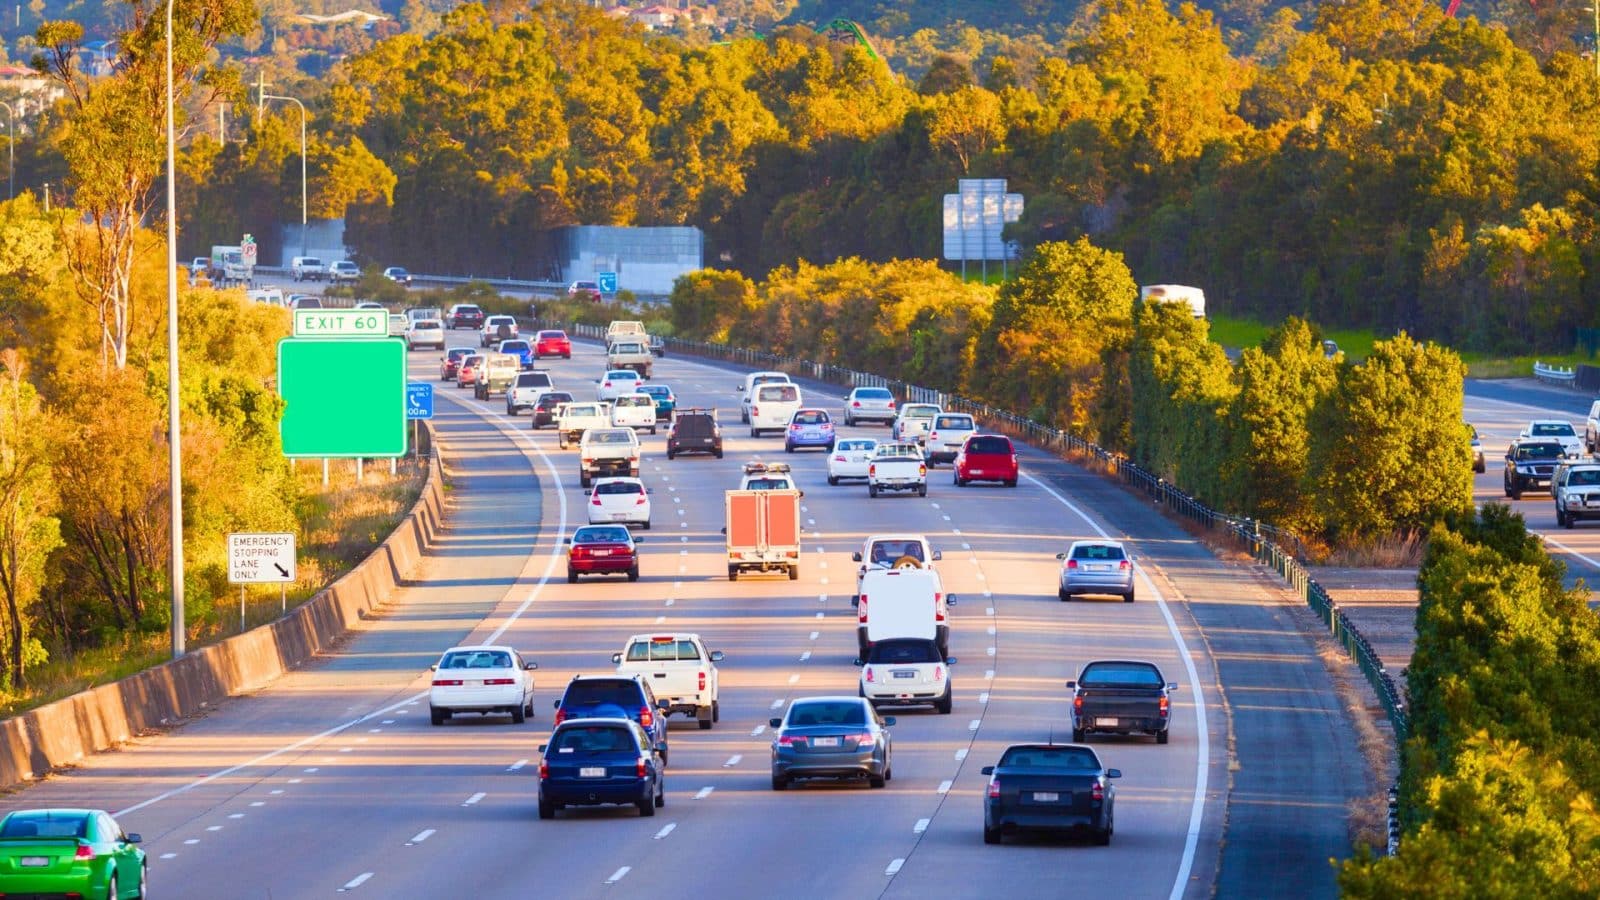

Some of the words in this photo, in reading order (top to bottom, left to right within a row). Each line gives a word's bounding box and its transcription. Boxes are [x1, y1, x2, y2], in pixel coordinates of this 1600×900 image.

[305, 317, 344, 329] EXIT
[355, 317, 377, 329] 60
[233, 537, 289, 546] EMERGENCY
[234, 548, 279, 557] STOPPING
[234, 559, 259, 568] LANE
[234, 570, 258, 579] ONLY
